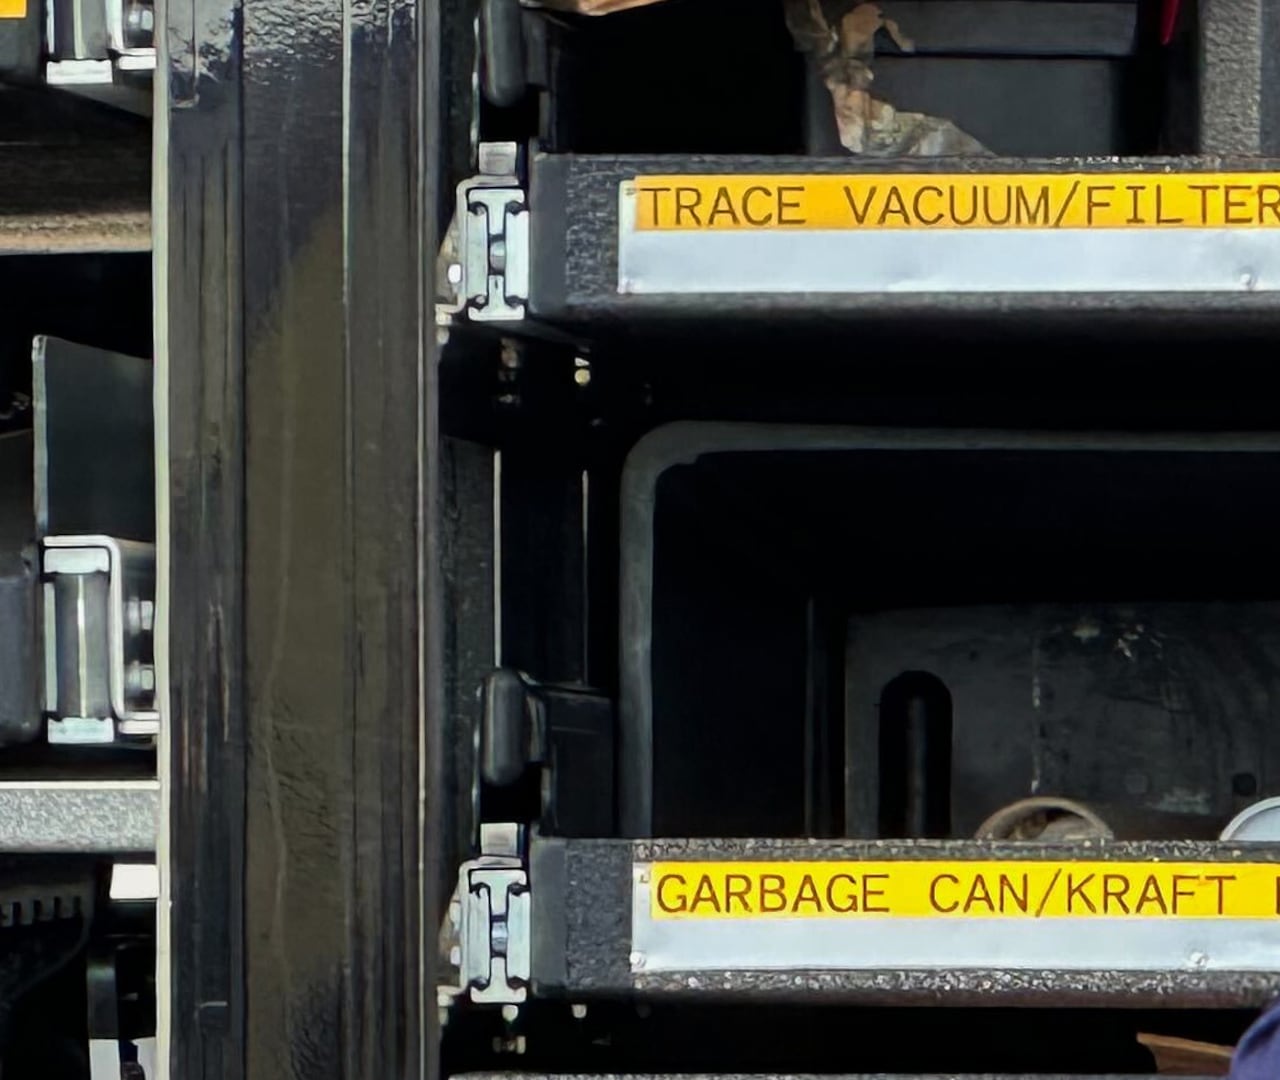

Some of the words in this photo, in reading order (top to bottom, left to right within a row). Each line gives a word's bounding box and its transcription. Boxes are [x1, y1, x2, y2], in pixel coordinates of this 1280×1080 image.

[640, 186, 806, 226] TRACE
[656, 873, 890, 914] GARBAGE
[929, 869, 1236, 917] CAN/KRAFT
